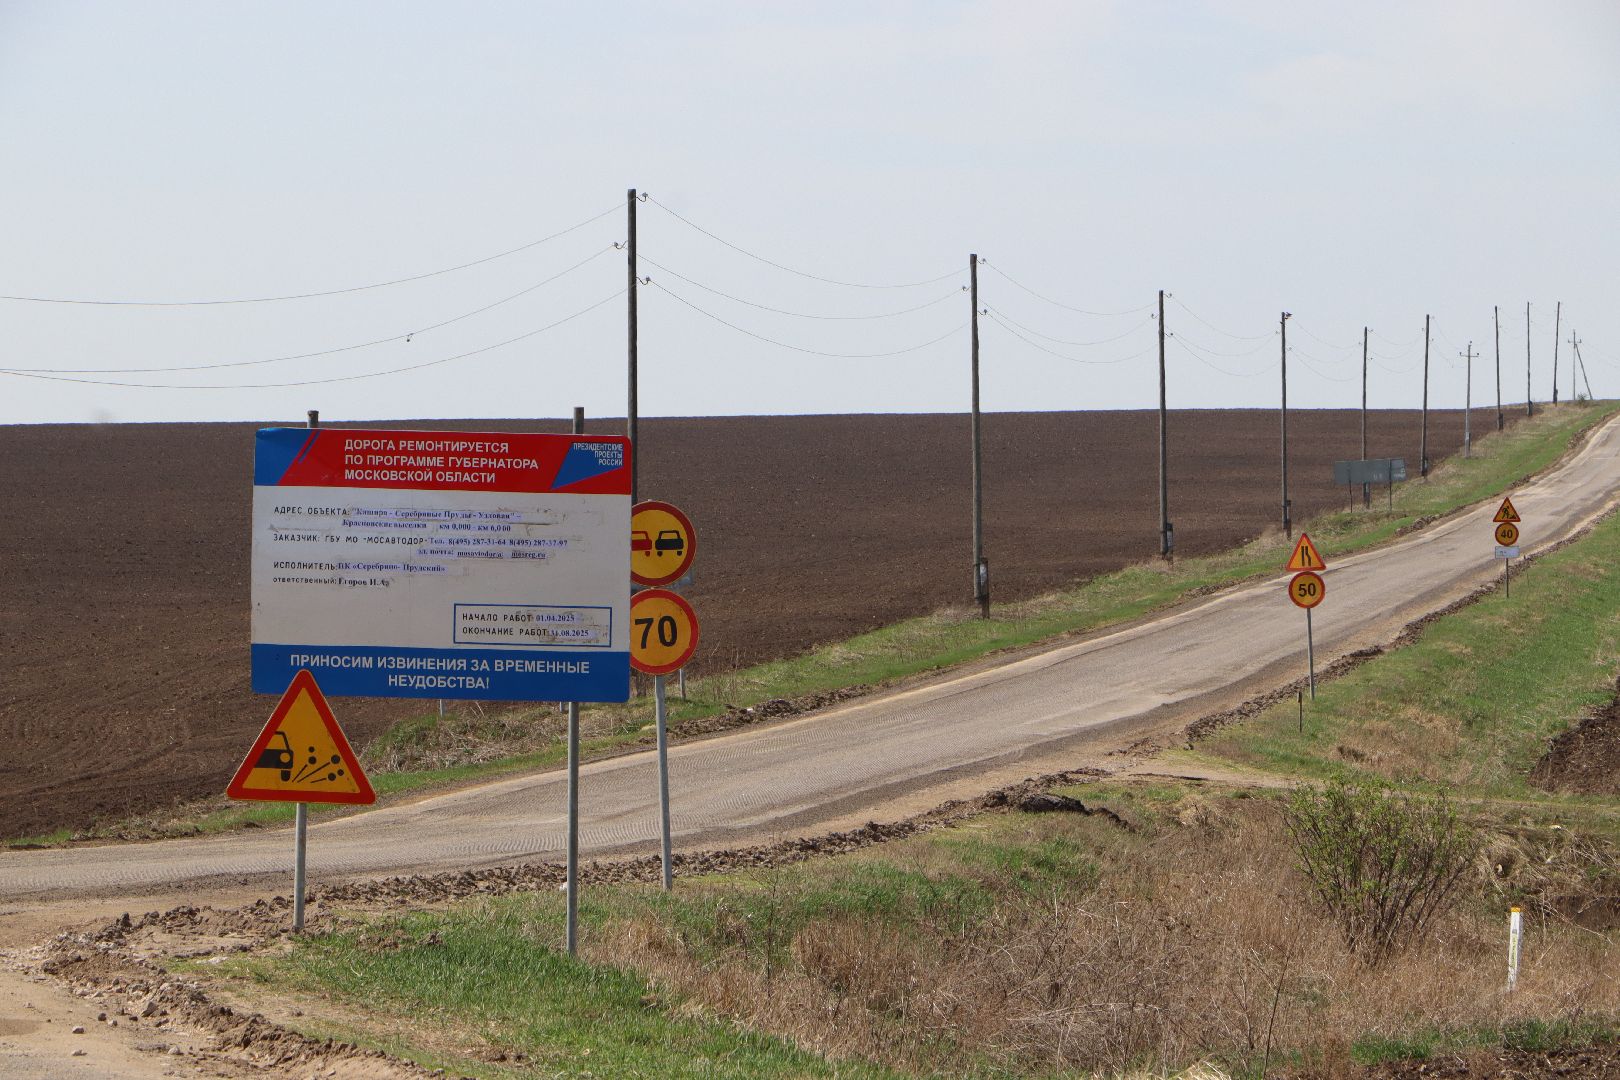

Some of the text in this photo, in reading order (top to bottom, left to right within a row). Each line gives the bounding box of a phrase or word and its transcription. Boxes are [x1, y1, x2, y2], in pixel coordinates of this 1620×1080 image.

[345, 439, 509, 454] ДОРОГА РЕМОНТИРУЕТСЯ
[573, 443, 623, 451] ПРЕЗИДЕНТСКИЕ
[345, 454, 539, 470] ПО ПРОГРАММЕ ГУБЕРНАТОРА
[345, 468, 496, 483] МОСКОВСКОЙ ОБЛАСТИ
[274, 506, 302, 515] АДРЕС
[307, 507, 350, 516] ОБЪЕКТА:
[273, 533, 320, 542] ЗАКАЗЧИК:
[325, 535, 341, 543] ГБУ
[1501, 529, 1513, 539] 40
[273, 562, 338, 571] ИСПОЛНИТЕЛЬ:
[338, 562, 351, 570] ПК
[272, 577, 337, 585] ответственный:
[1298, 583, 1316, 597] 50
[462, 613, 498, 621] НАЧАЛО
[462, 627, 514, 635] ОКОНЧАНИЕ
[634, 615, 678, 649] 70
[290, 654, 590, 673] ПРИНОСИМ ИЗВИНЕНИЯ ЗА ВРЕМЕННЫЕ
[388, 675, 490, 689] НЕУДОБСТВА!
